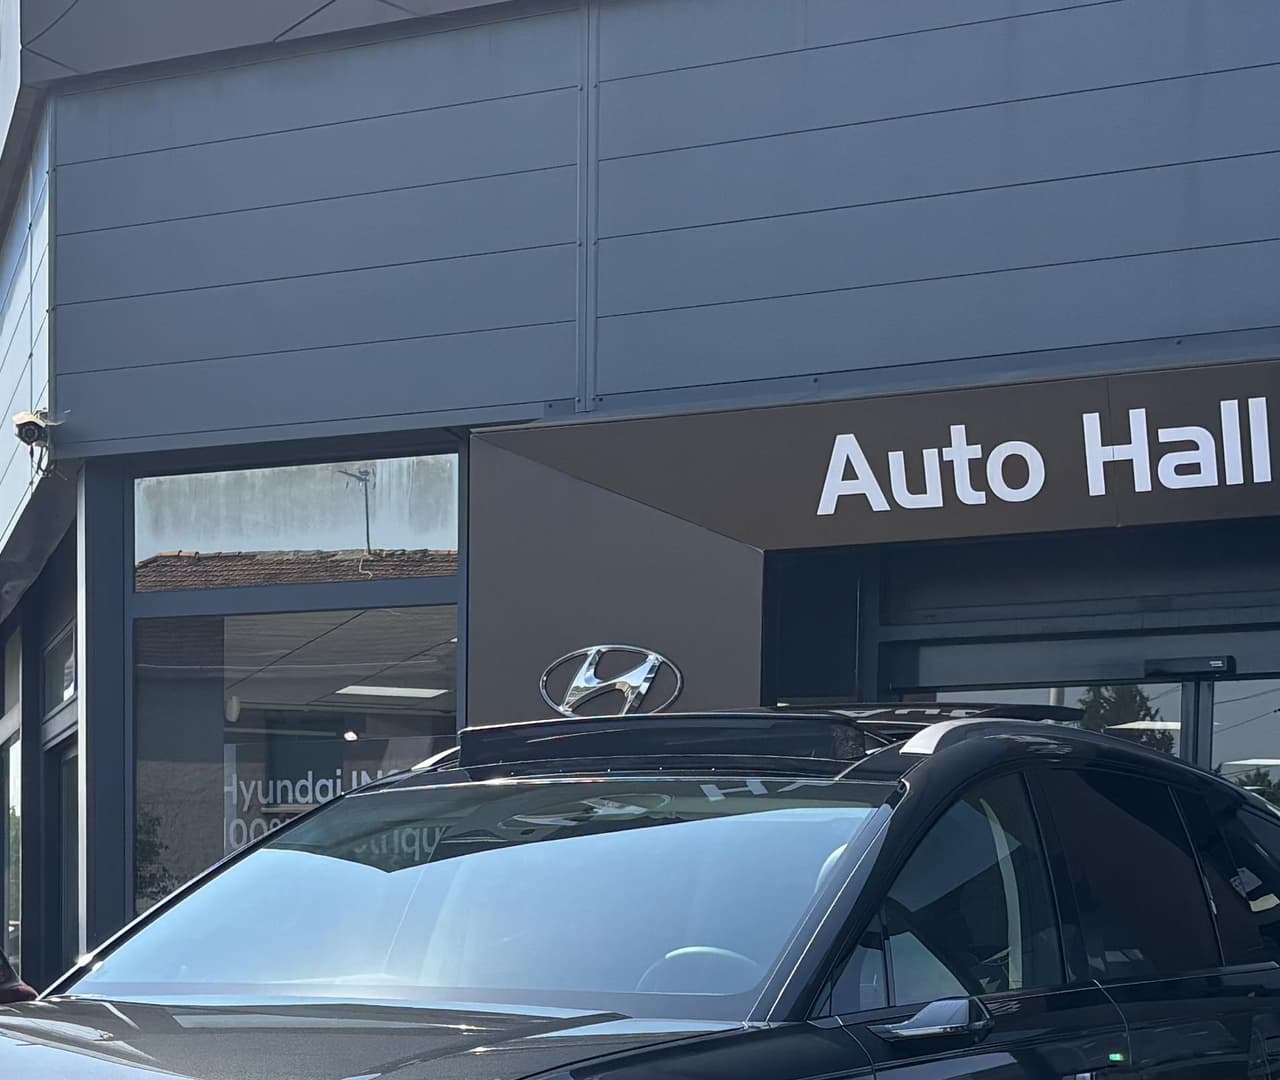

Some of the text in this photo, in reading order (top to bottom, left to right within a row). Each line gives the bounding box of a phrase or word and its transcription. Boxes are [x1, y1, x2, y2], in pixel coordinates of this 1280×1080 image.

[817, 424, 1046, 515] Auto
[1082, 396, 1272, 497] Hall
[224, 768, 342, 812] Hyundai
